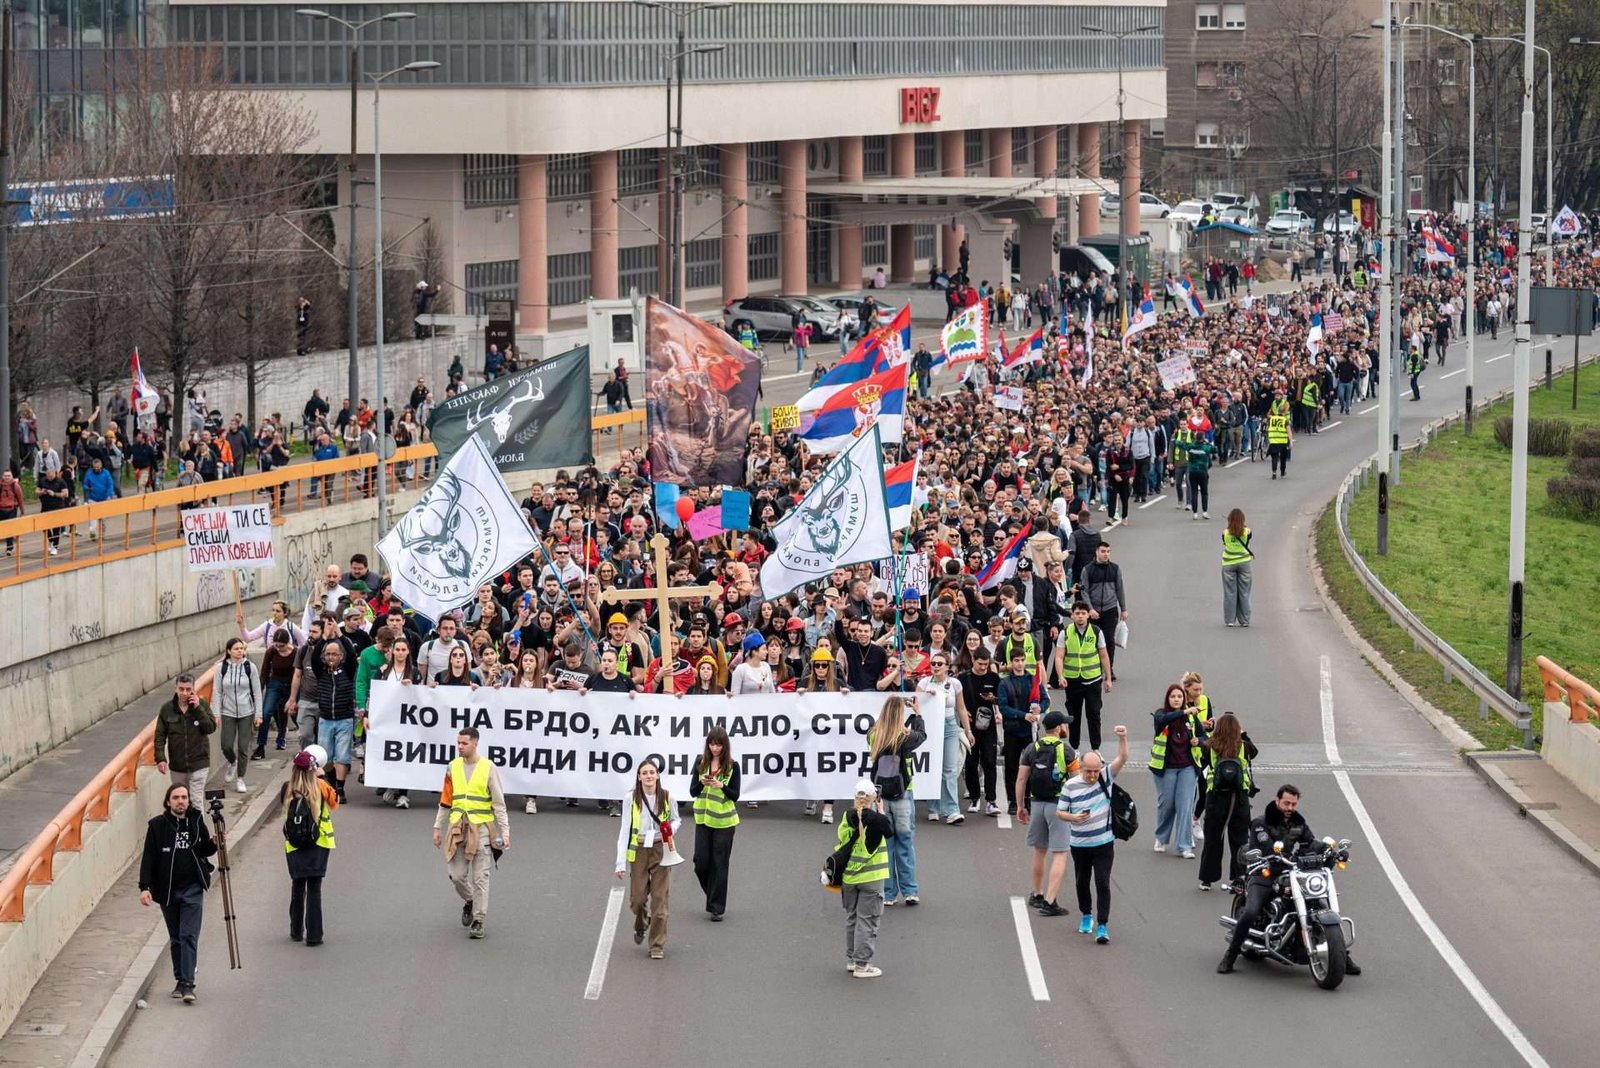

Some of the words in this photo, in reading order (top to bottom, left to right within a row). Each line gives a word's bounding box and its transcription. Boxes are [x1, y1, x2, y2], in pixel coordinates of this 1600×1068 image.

[900, 87, 941, 124] BIGZ
[184, 511, 228, 531] СМЕШИ
[232, 509, 249, 528] ТИ
[188, 529, 231, 546] СМЕШИ
[189, 544, 226, 564] ЛАУРА
[227, 541, 273, 561] КОВЕШИ
[881, 565, 907, 583] OBAZ
[400, 703, 439, 728] КО
[451, 707, 493, 729] НА
[504, 709, 600, 739] БРДО,
[670, 715, 690, 737] И
[703, 714, 800, 741] МАЛО,
[383, 740, 456, 765] ВИШ
[488, 745, 576, 774] ВИДИ
[588, 751, 633, 773] НО
[742, 752, 808, 778] ПОД
[817, 751, 930, 778] БРДМ
